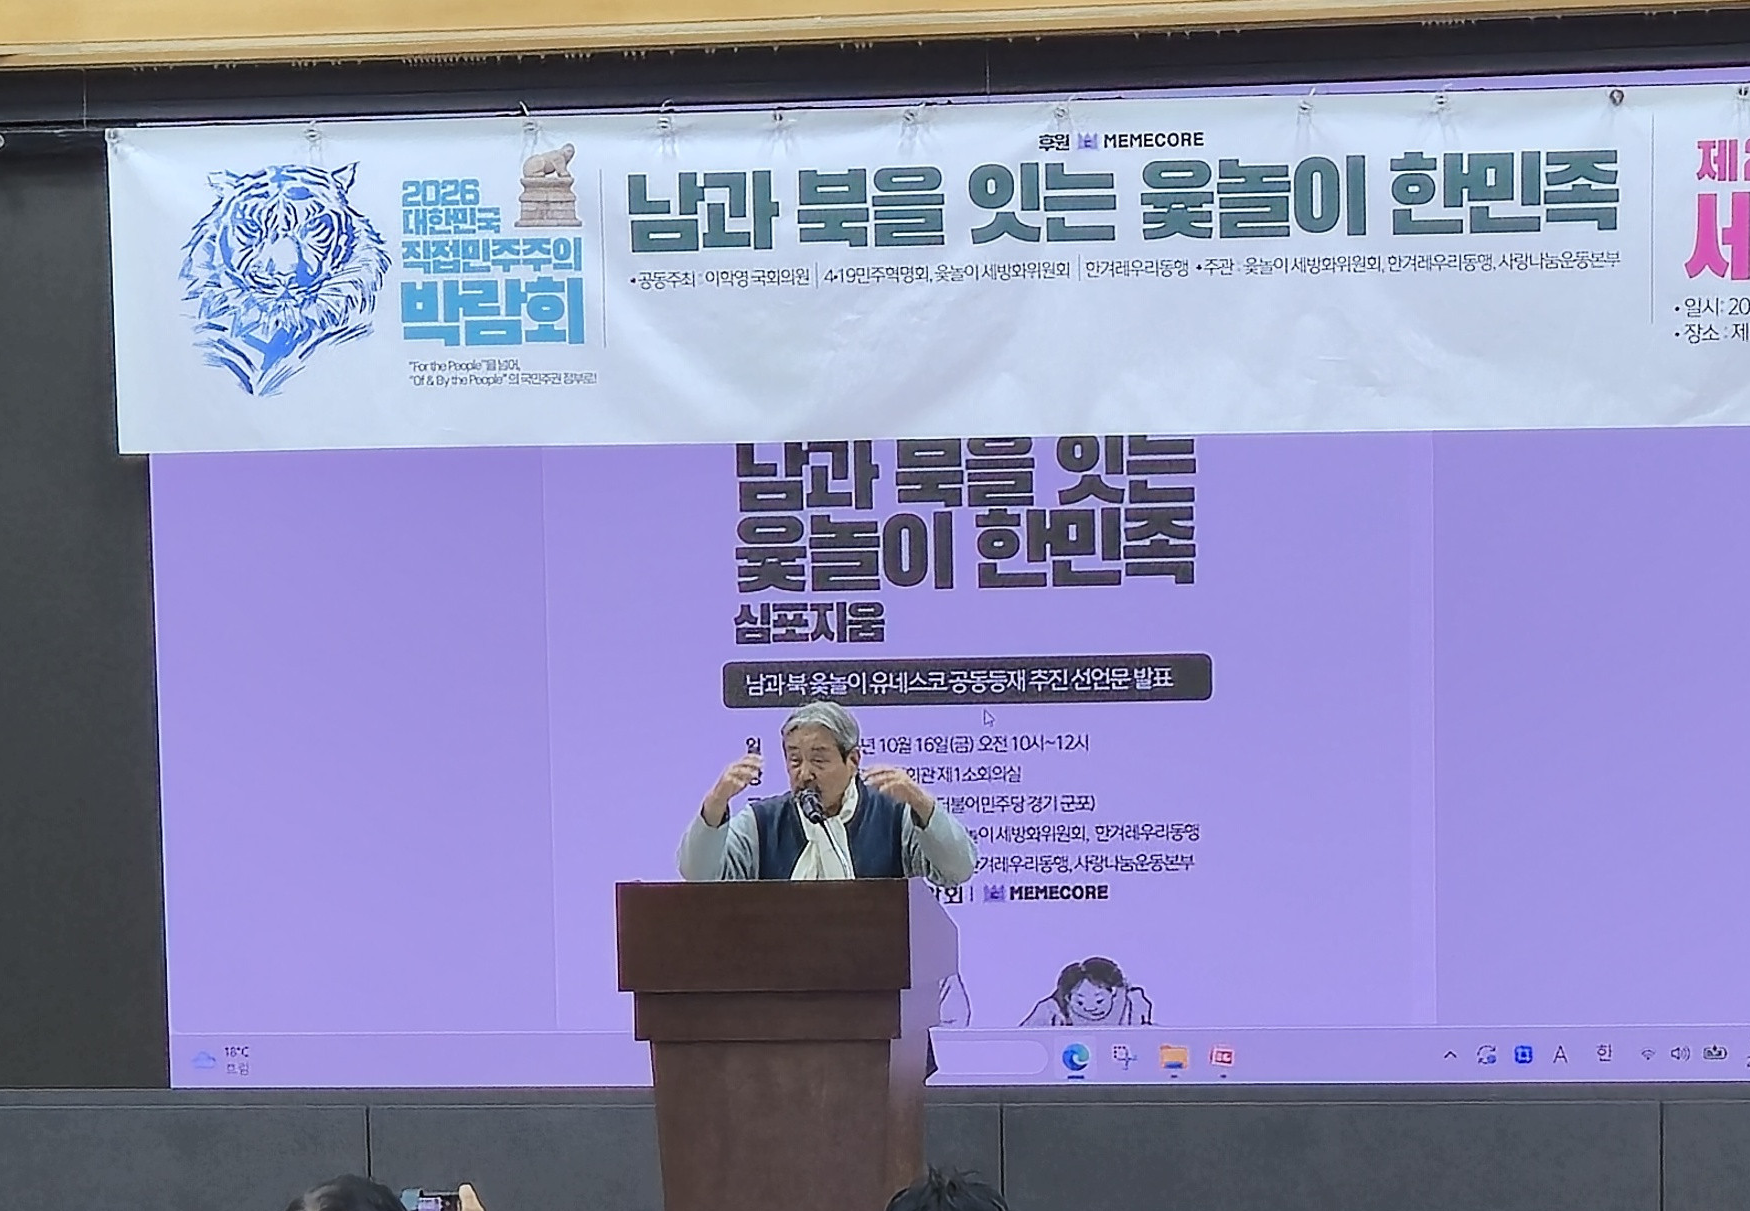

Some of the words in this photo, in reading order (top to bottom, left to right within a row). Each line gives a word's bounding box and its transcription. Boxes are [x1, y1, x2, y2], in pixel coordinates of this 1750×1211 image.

[1038, 133, 1070, 151] 후원
[1103, 132, 1204, 149] MEMECORE
[402, 179, 480, 207] 2026
[628, 170, 780, 253] 남과
[797, 166, 945, 248] 북을
[968, 162, 1117, 245] 잇는
[1140, 155, 1366, 240] 윷놀이
[1390, 149, 1620, 235] 한민족
[403, 207, 501, 236] 대한민국
[401, 237, 582, 274] 직접민주주의
[705, 269, 749, 288] 이학영
[751, 268, 810, 287] 국회의원
[981, 260, 1070, 281] 세방화위원회
[1086, 259, 1189, 278] 한겨레우리동행
[1498, 250, 1621, 271] 사랑나눔운동본부
[401, 276, 585, 347] 박람회
[736, 440, 879, 512] 남과
[1056, 435, 1197, 505] 잇는
[735, 511, 954, 592] 윷놀이
[975, 506, 1197, 589] 한민족
[734, 601, 885, 645] 심포지움
[746, 673, 785, 696] 남과
[869, 671, 948, 694] 유네스코
[949, 669, 1026, 693] 공동등재
[1029, 668, 1069, 692] 추진
[1071, 667, 1132, 691] 선언문
[1134, 666, 1174, 689] 발표
[880, 736, 911, 754] 10월
[916, 735, 974, 754] 16일(금)
[978, 735, 1008, 753] 오전
[1012, 734, 1089, 752] 10시~12시
[1095, 823, 1200, 842] 한겨레우리동행
[1010, 885, 1109, 900] MEMECORE
